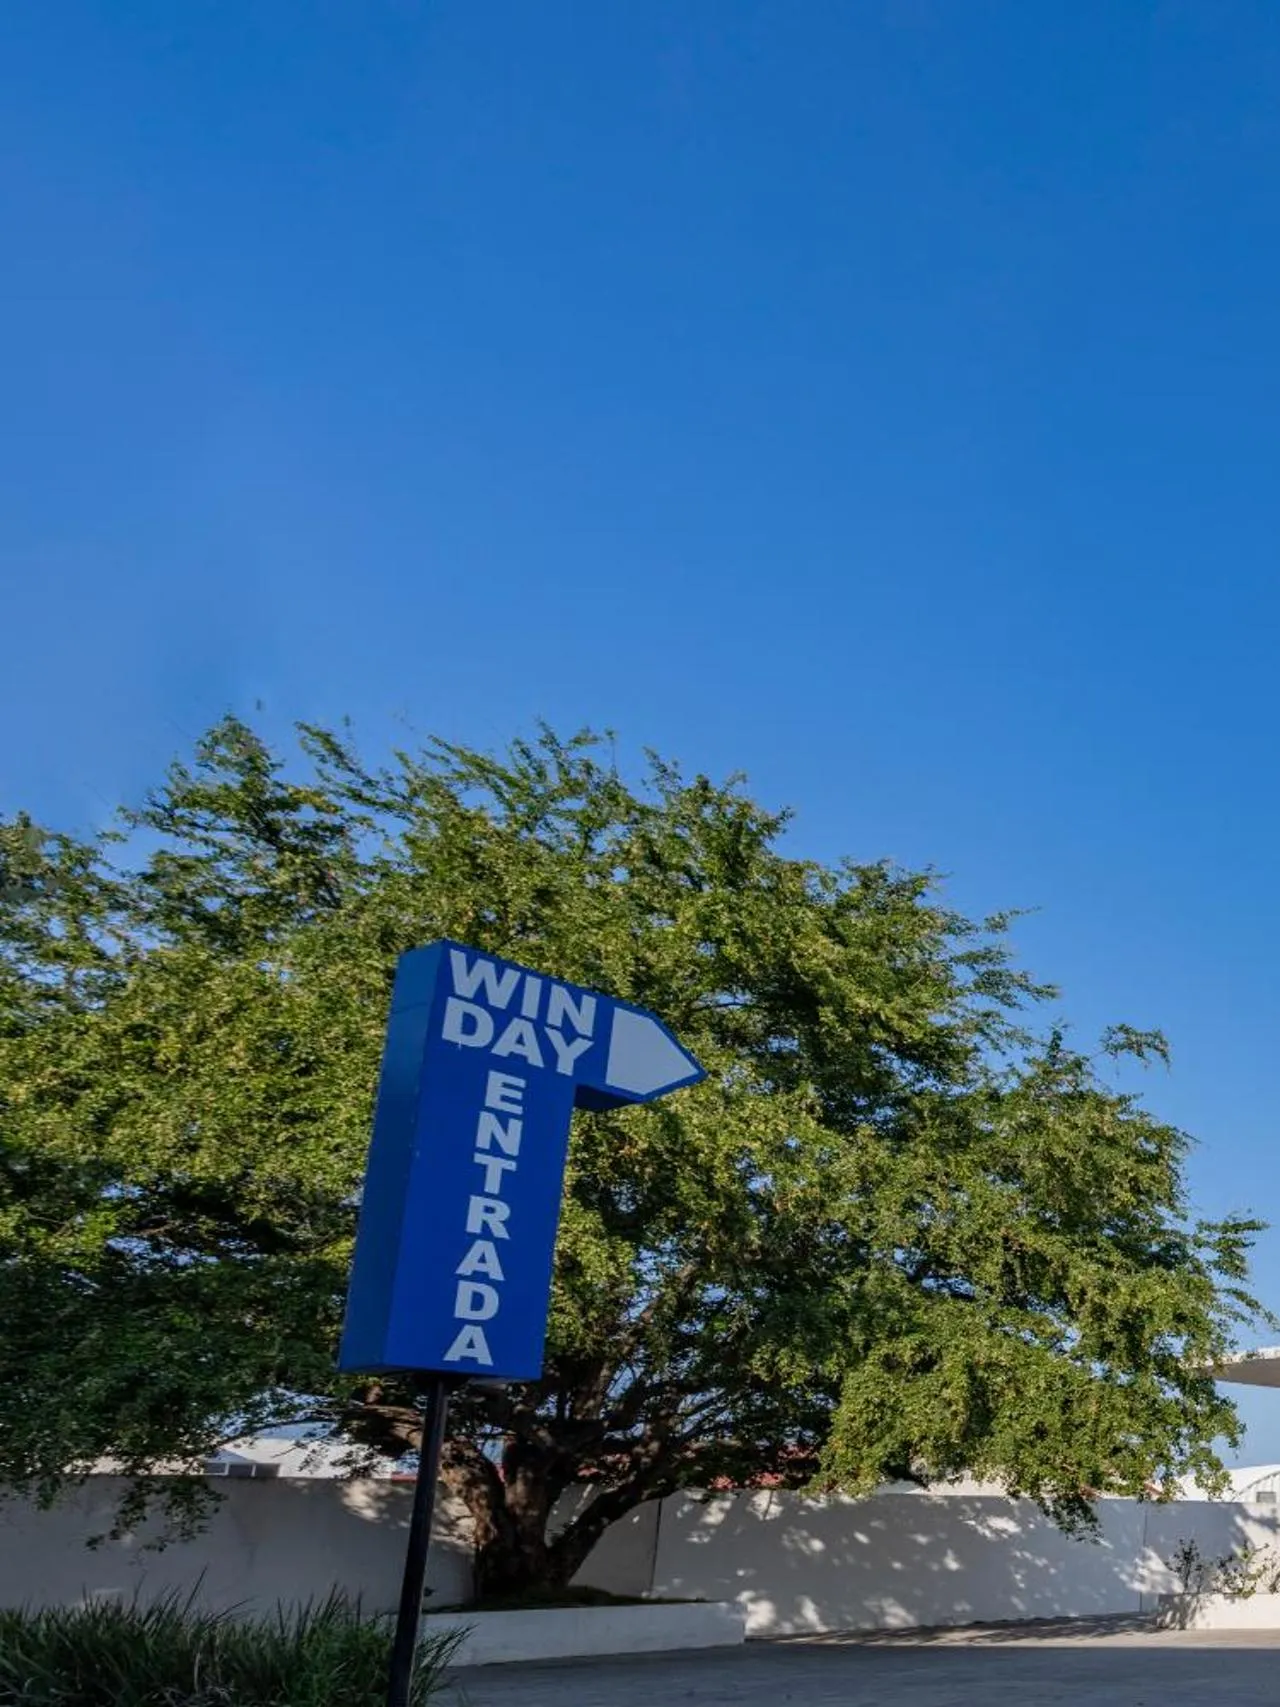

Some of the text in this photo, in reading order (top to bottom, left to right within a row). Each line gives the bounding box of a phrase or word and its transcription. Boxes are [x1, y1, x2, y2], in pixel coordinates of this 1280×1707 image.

[441, 997, 594, 1076] DAY
[449, 949, 597, 1038] WIN
[443, 1070, 528, 1367] ENTRADA
